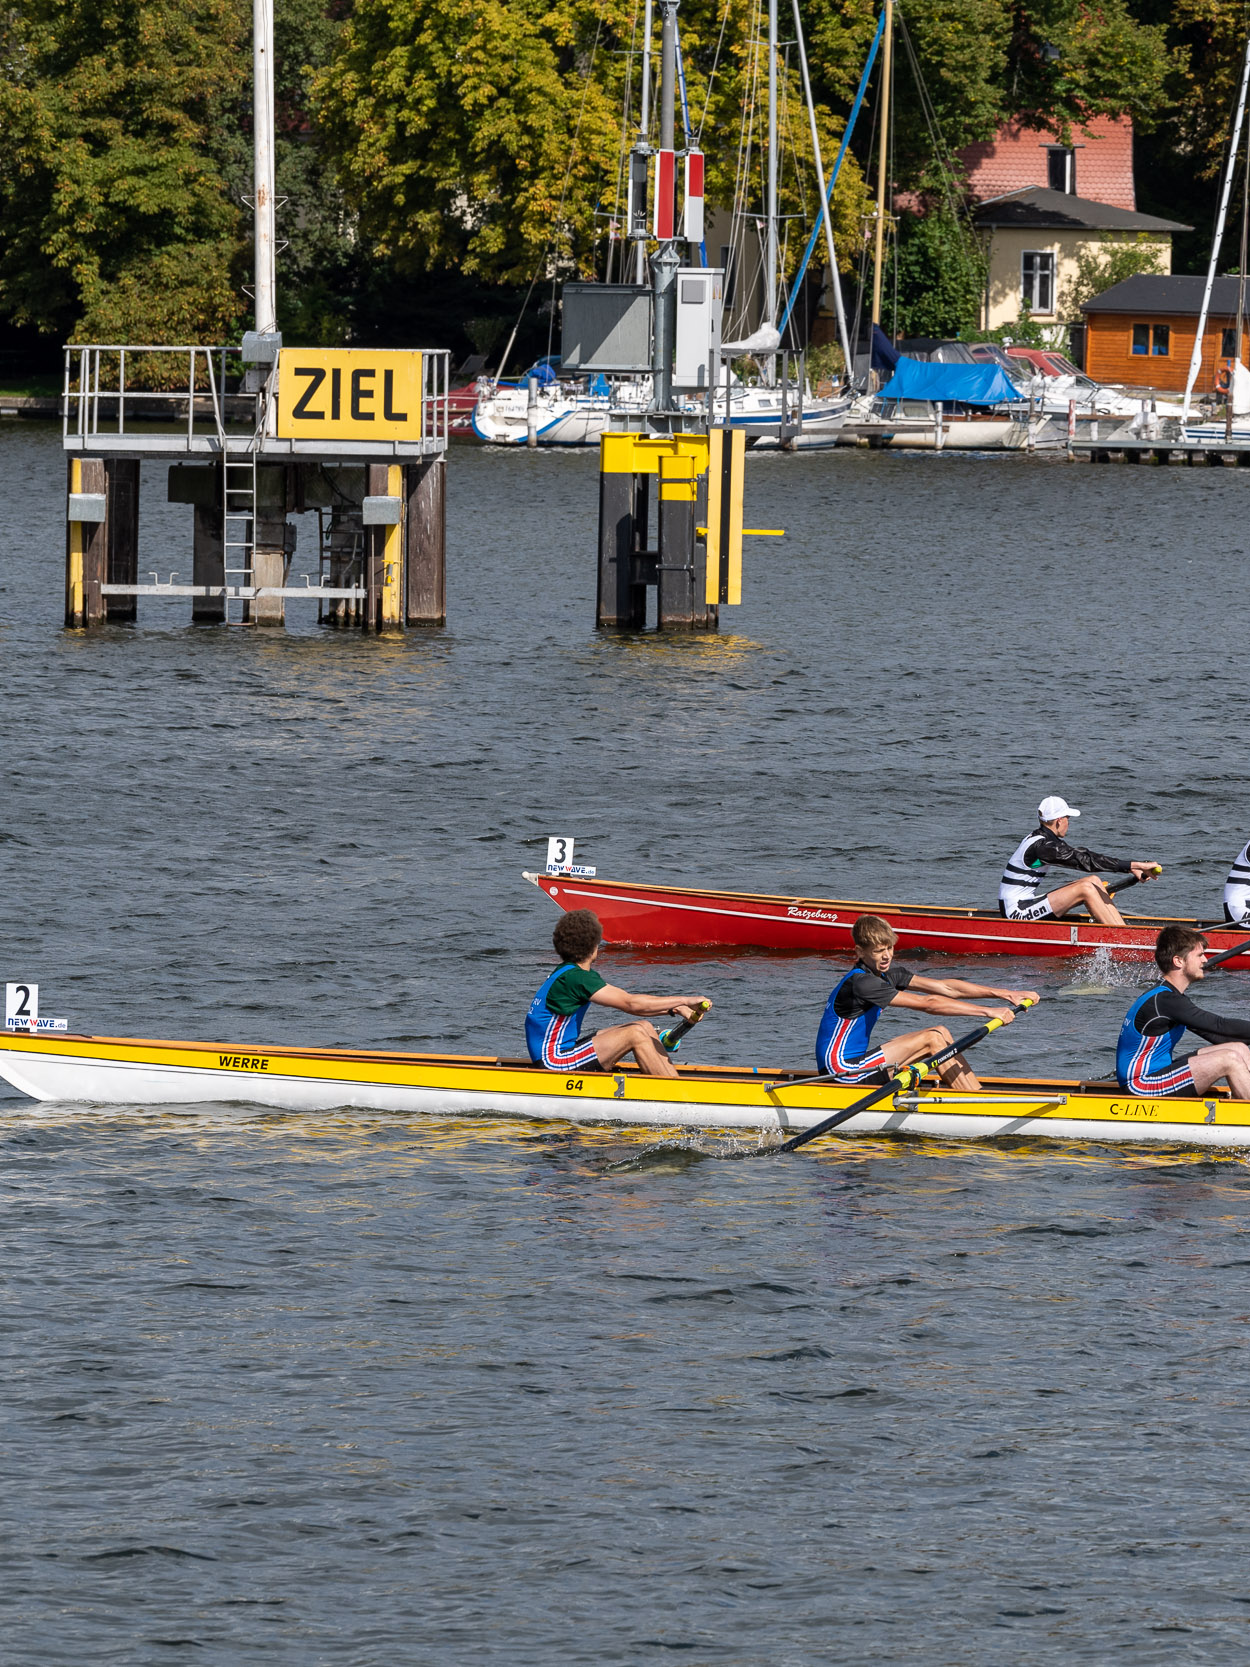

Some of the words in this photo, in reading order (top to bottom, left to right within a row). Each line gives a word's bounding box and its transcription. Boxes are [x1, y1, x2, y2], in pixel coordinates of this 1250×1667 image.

[292, 367, 408, 422] ZIEL
[554, 838, 567, 864] 3
[787, 906, 838, 922] Ratzeburg
[15, 985, 31, 1017] 2
[219, 1055, 269, 1070] WERRE
[565, 1079, 584, 1091] 64
[1109, 1103, 1159, 1117] C-LINE
